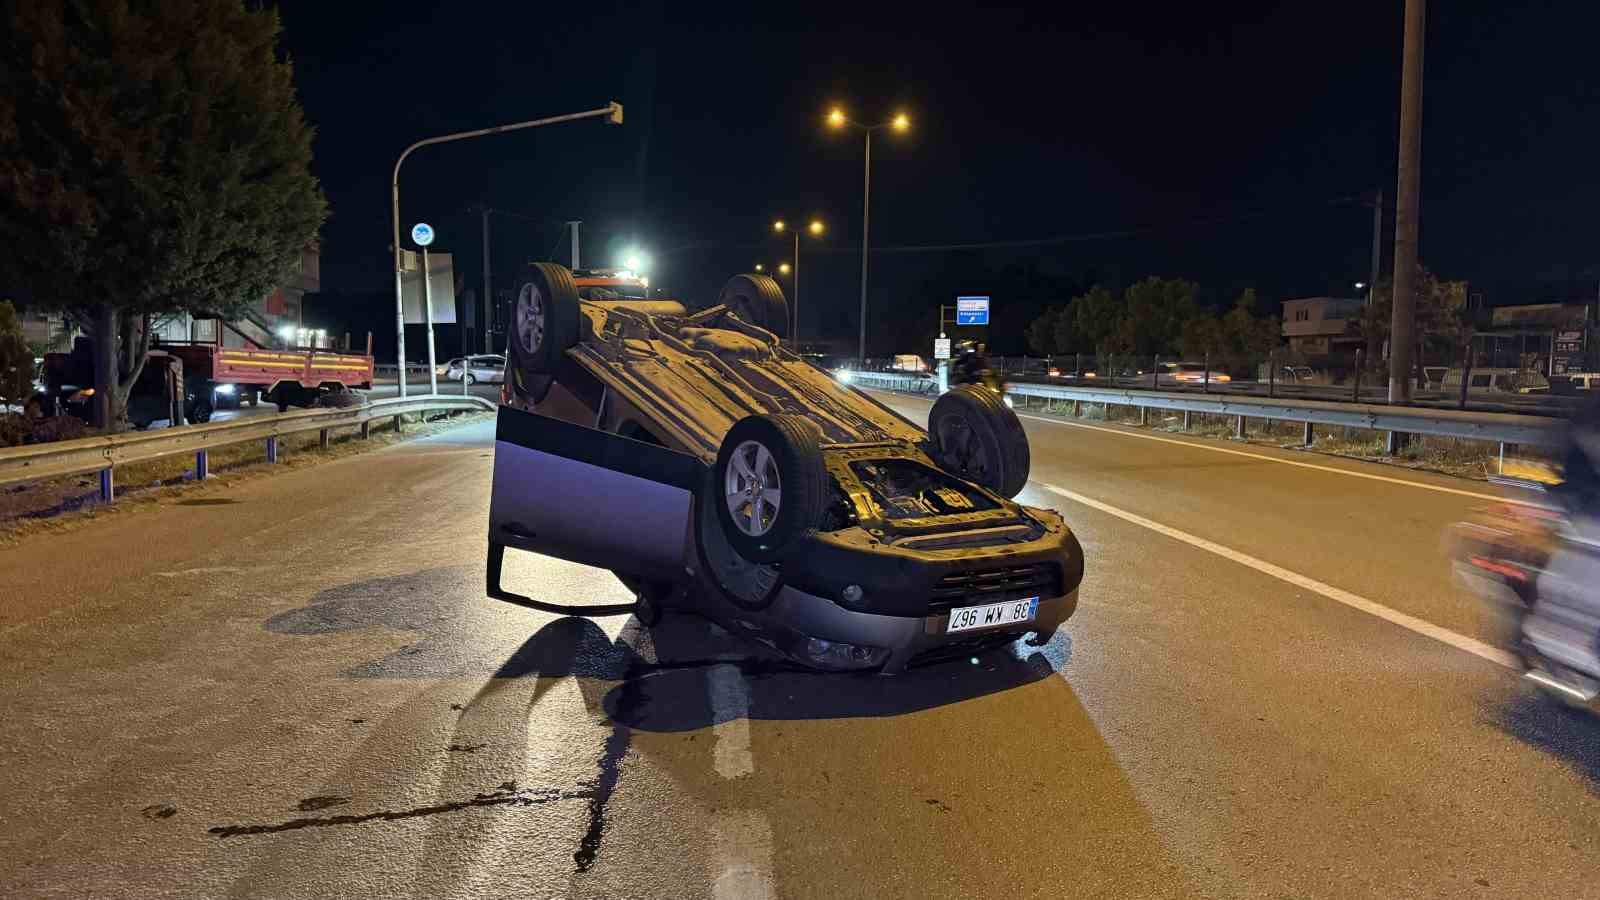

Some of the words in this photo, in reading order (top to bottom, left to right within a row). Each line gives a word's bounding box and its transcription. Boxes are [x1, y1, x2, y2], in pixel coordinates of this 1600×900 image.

[952, 610, 977, 628] 967
[984, 606, 1003, 624] KM
[1013, 602, 1029, 619] 38
